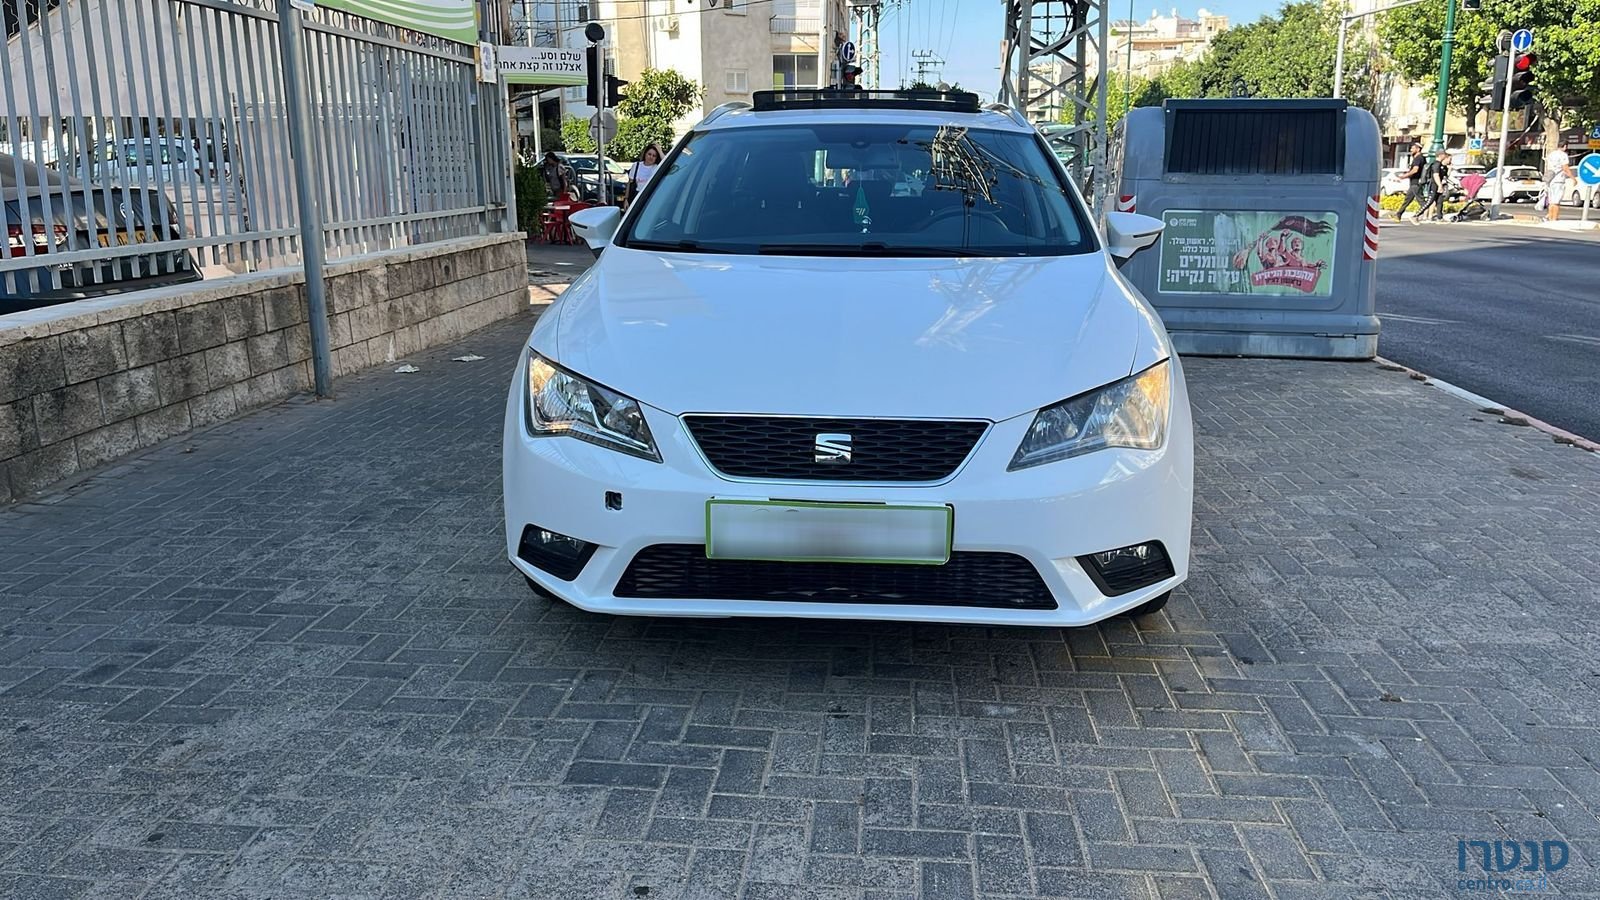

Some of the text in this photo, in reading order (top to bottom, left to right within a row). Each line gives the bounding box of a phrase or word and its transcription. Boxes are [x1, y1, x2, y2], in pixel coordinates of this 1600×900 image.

[531, 51, 581, 61] שלם וסע...
[519, 61, 540, 72] קצת
[542, 62, 553, 71] זה
[556, 62, 582, 72] אצלנו
[1165, 269, 1204, 285] נקייה!
